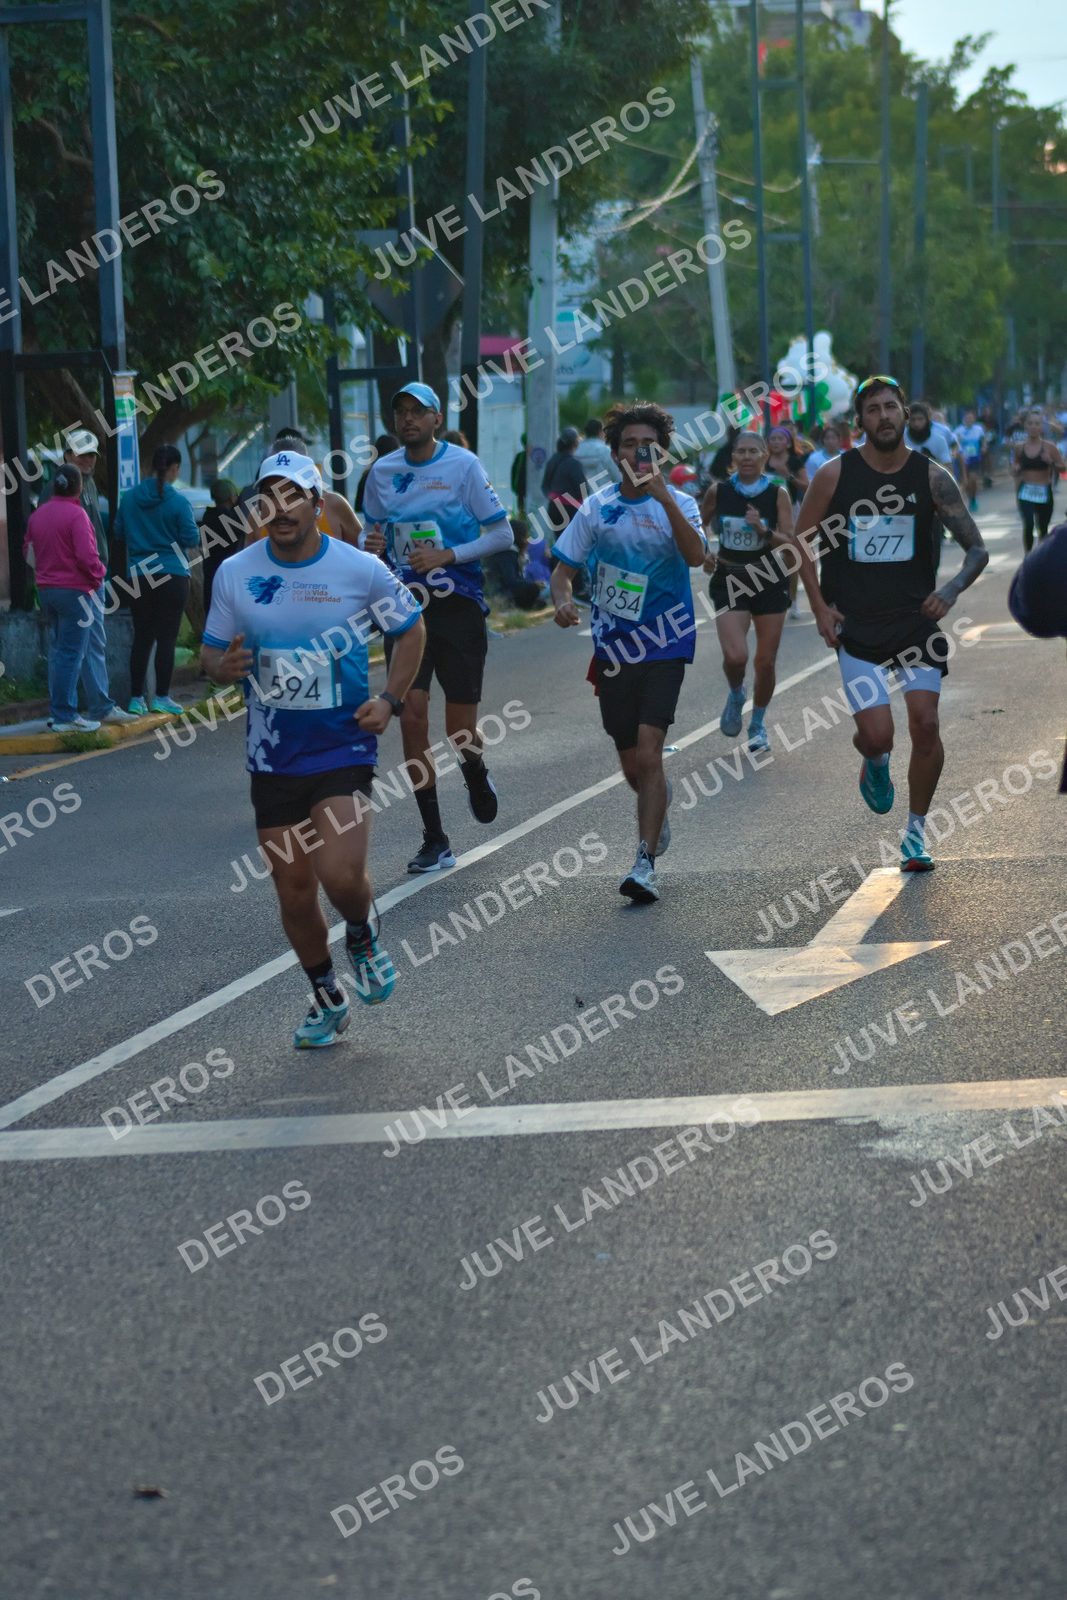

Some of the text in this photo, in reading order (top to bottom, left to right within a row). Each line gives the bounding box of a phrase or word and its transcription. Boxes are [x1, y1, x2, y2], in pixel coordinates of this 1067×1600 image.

[276, 454, 291, 466] LA
[864, 535, 904, 557] 677
[271, 675, 321, 702] 594
